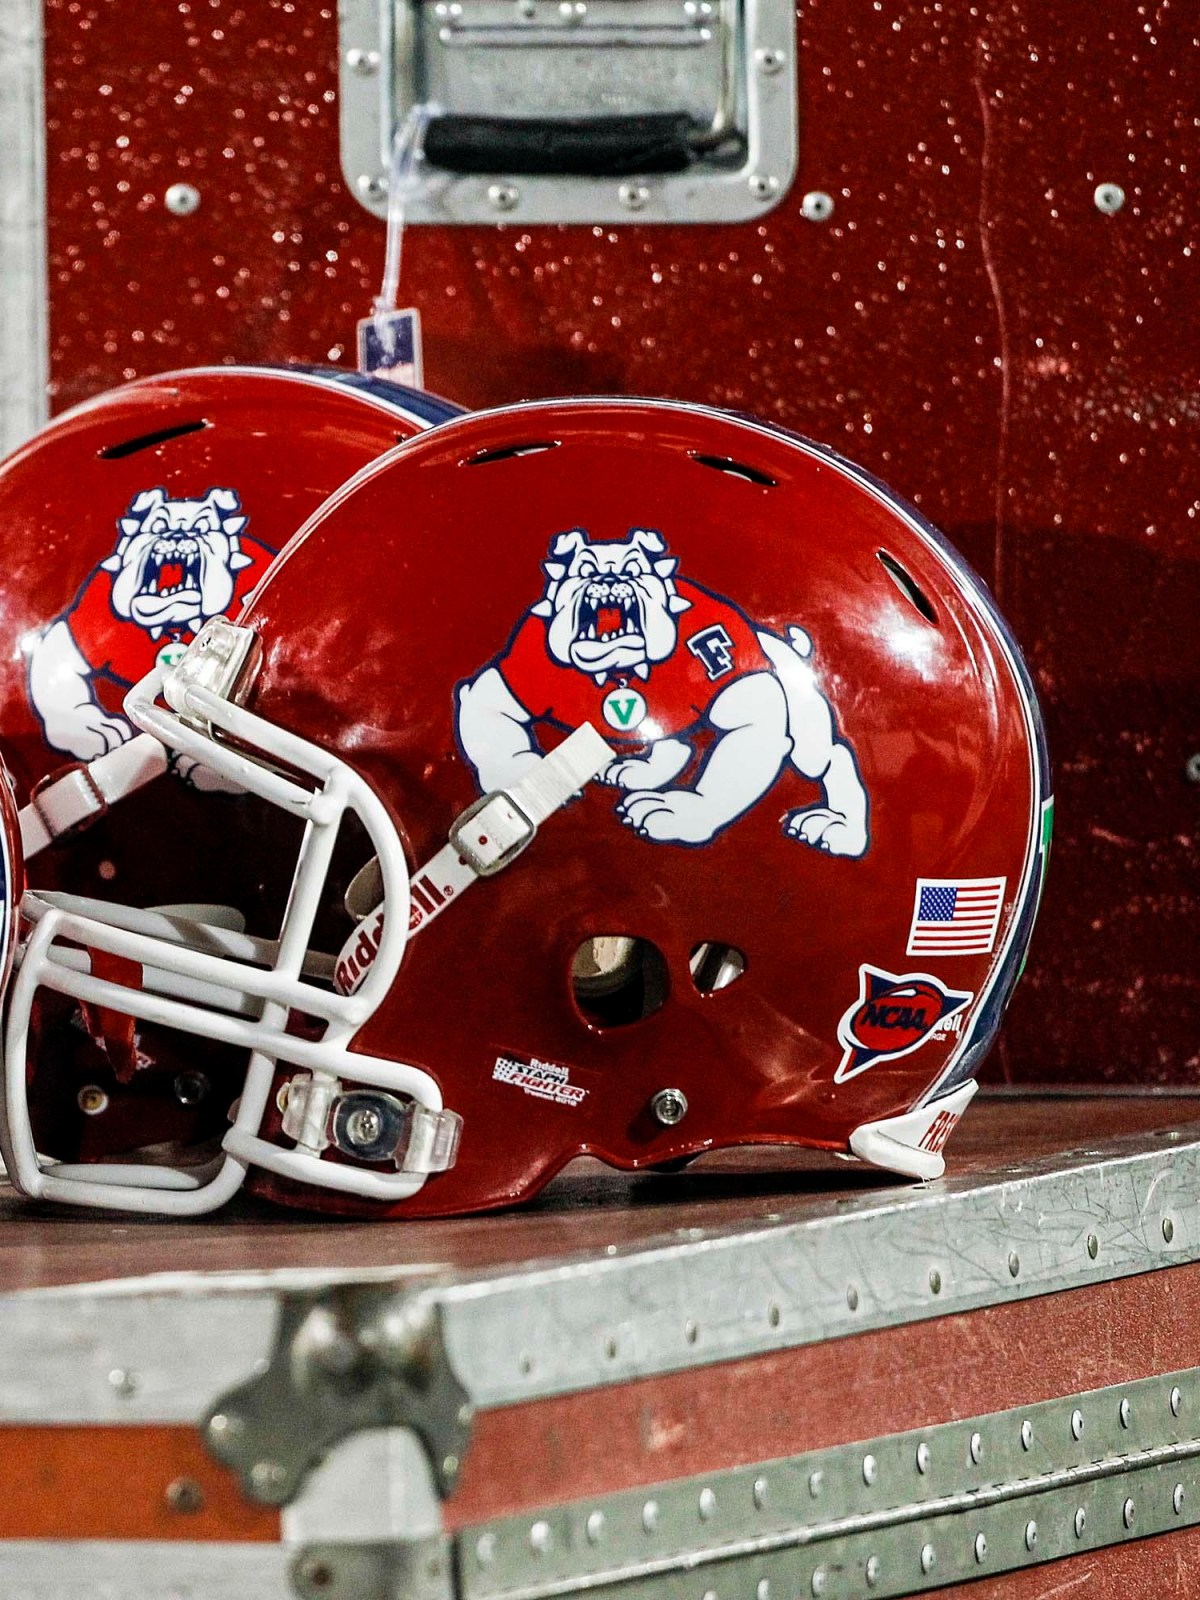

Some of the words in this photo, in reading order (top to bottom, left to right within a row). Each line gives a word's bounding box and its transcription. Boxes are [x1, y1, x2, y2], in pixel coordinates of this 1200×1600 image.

[687, 624, 732, 681] F
[608, 698, 637, 725] V
[860, 1002, 927, 1031] NCAA
[509, 1072, 585, 1100] FIGHTER
